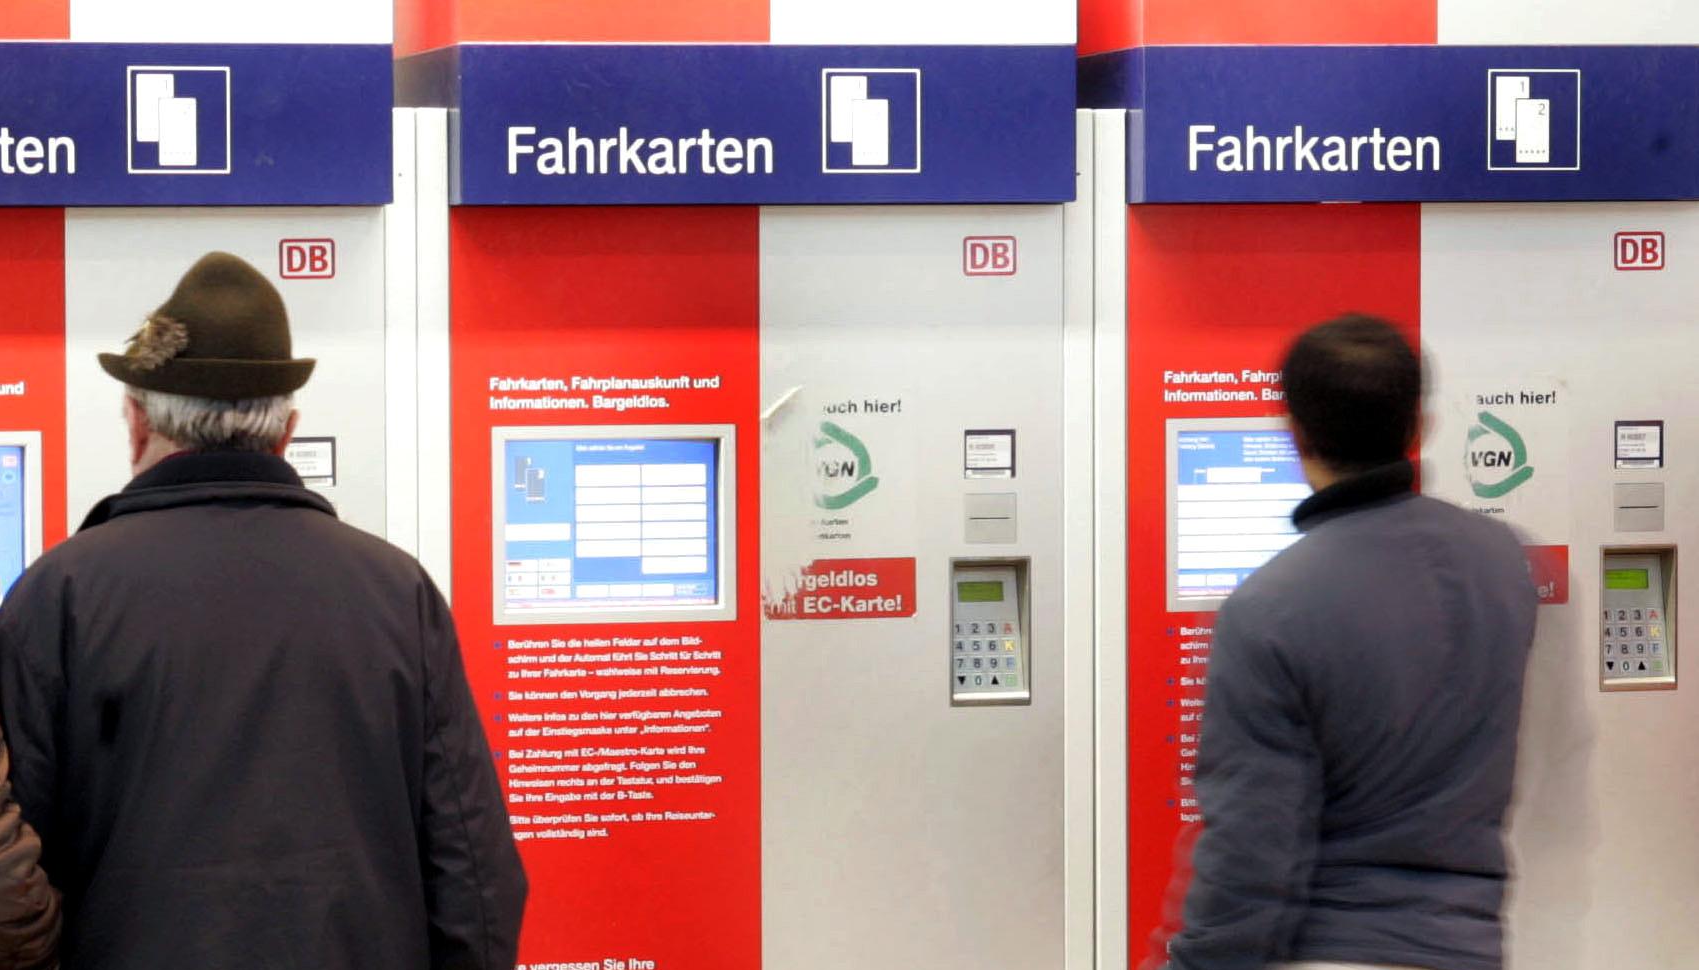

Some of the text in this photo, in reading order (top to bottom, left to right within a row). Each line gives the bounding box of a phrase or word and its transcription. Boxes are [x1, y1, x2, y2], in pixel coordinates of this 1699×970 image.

[509, 127, 773, 174] Fahrkarten
[1189, 125, 1439, 171] Fahrkarten
[970, 244, 1010, 270] DB
[1620, 239, 1659, 265] DB
[287, 246, 328, 272] DB
[490, 376, 719, 392] Fahrkarten, Fahrplanauskunft und
[1164, 371, 1238, 384] Fahrkarten,
[1165, 389, 1257, 402] Informationen.
[1478, 391, 1555, 404] auch hier!
[490, 395, 669, 411] Informationen. Bargeldlos.
[824, 400, 901, 413] uch hier!
[1472, 451, 1511, 466] VGN
[803, 595, 902, 614] EC-Karte!
[1604, 611, 1608, 619] 1
[1618, 610, 1625, 620] 2
[1634, 610, 1640, 620] 3
[955, 623, 995, 633] 1 2 3
[1620, 627, 1627, 637] 5
[1635, 627, 1642, 637] 6
[955, 641, 963, 650] 4
[973, 640, 980, 650] 5
[989, 640, 996, 650] 6
[1605, 644, 1611, 654] 7
[1621, 644, 1628, 654] 8
[1637, 644, 1644, 653] 9
[957, 658, 997, 668] 7 8 9
[1623, 661, 1629, 670] 0
[975, 675, 982, 685] 0
[604, 959, 625, 970] Sie
[629, 958, 654, 970] Ihre
